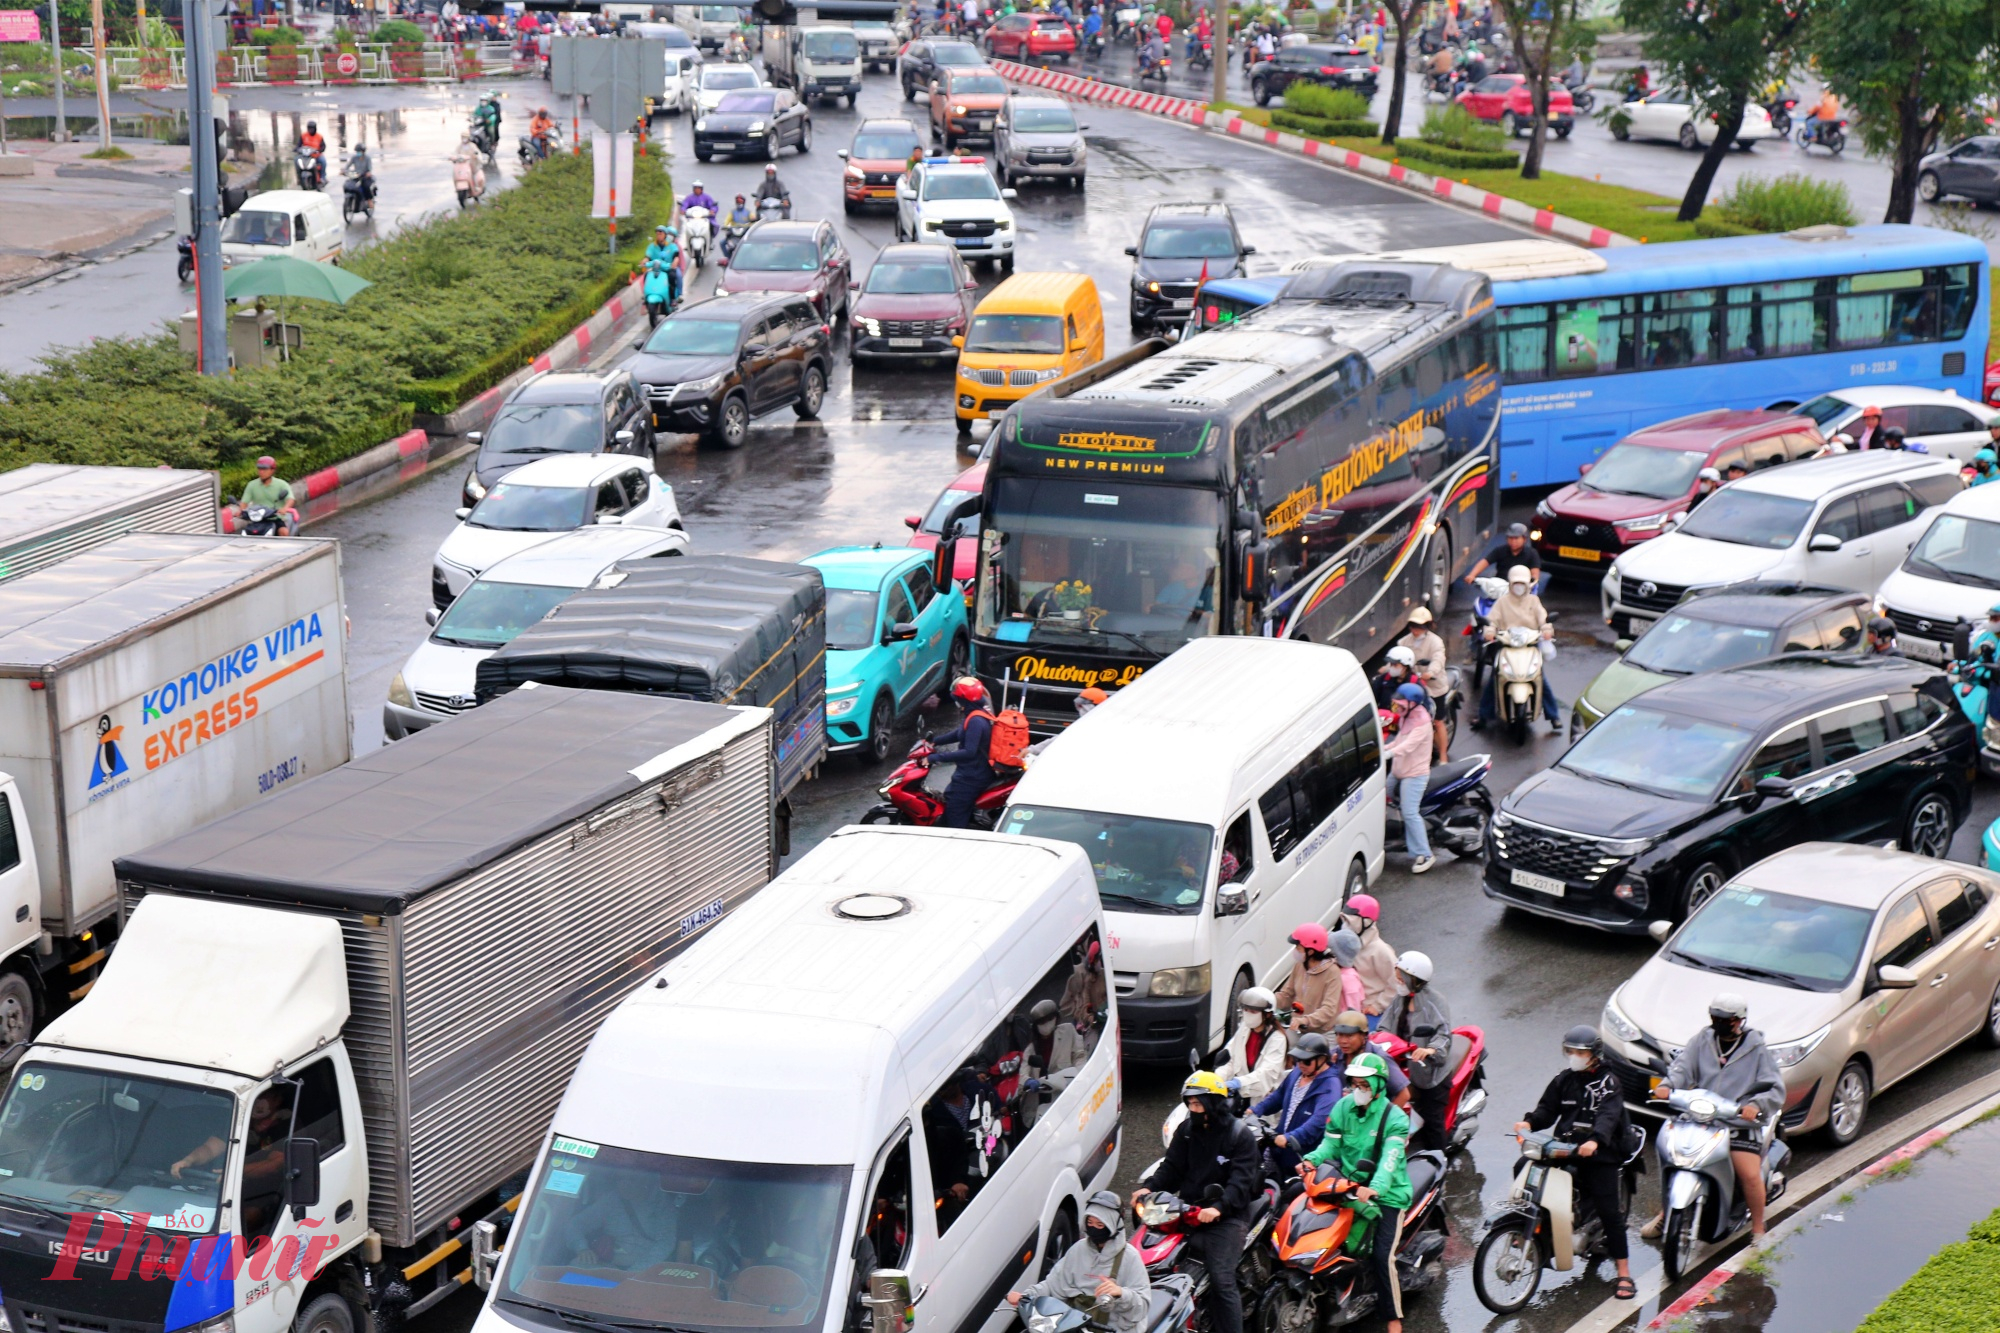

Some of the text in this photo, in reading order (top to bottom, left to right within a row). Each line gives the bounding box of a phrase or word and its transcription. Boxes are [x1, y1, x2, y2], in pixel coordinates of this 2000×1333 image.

[1058, 432, 1156, 452] LIMOUSINE
[1046, 458, 1165, 474] NEW PREMIUM
[1321, 409, 1424, 510] PHƯƠNG LINH
[1266, 486, 1318, 538] LIMOUSINE
[1015, 656, 1099, 688] Phương
[144, 686, 259, 770] EXPRESS
[1302, 838, 1319, 860] TRUNG
[1319, 816, 1338, 846] CHUYỂN
[1516, 873, 1560, 893] 51L-237.11
[553, 1140, 564, 1149] XE
[48, 1241, 110, 1264] ISUZU
